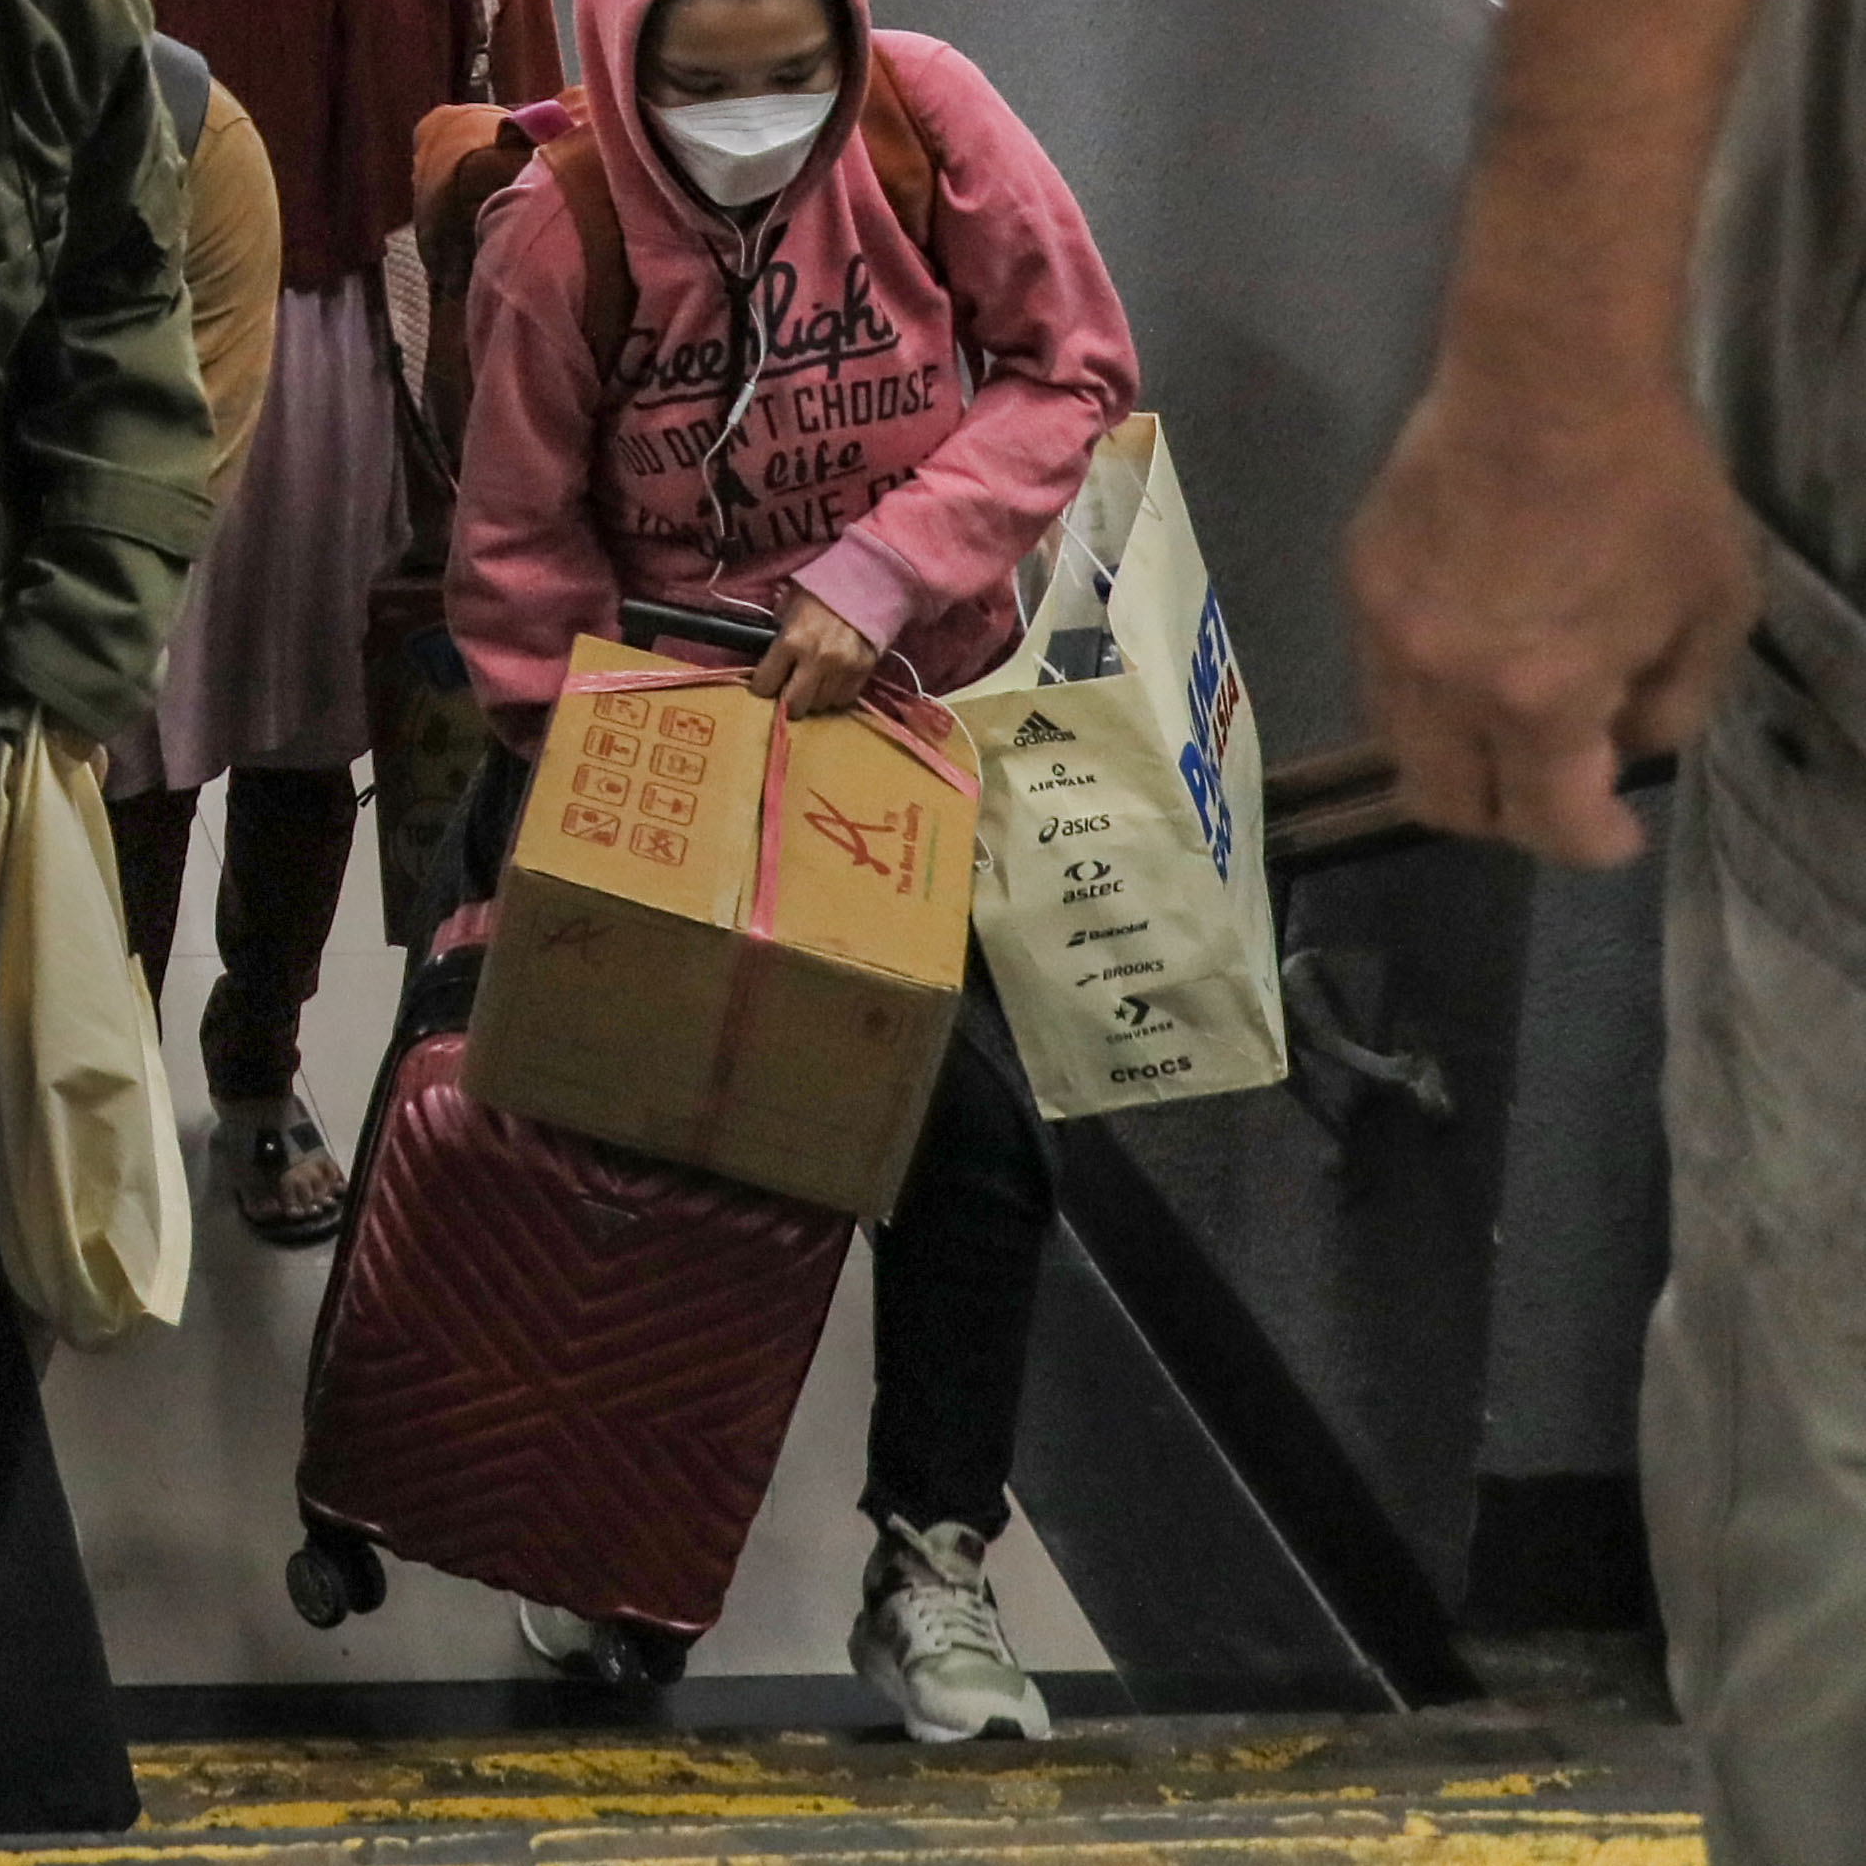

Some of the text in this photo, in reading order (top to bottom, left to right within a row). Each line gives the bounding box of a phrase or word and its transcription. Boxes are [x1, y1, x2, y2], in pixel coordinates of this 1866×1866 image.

[793, 365, 938, 435] CHOOSE
[1029, 775, 1097, 793] AIRWALK
[1061, 814, 1111, 836] asics
[1062, 880, 1125, 904] astec
[1102, 959, 1165, 982] BROOKS
[1105, 1021, 1174, 1045] CONVERSE
[1110, 1056, 1193, 1083] crocs
